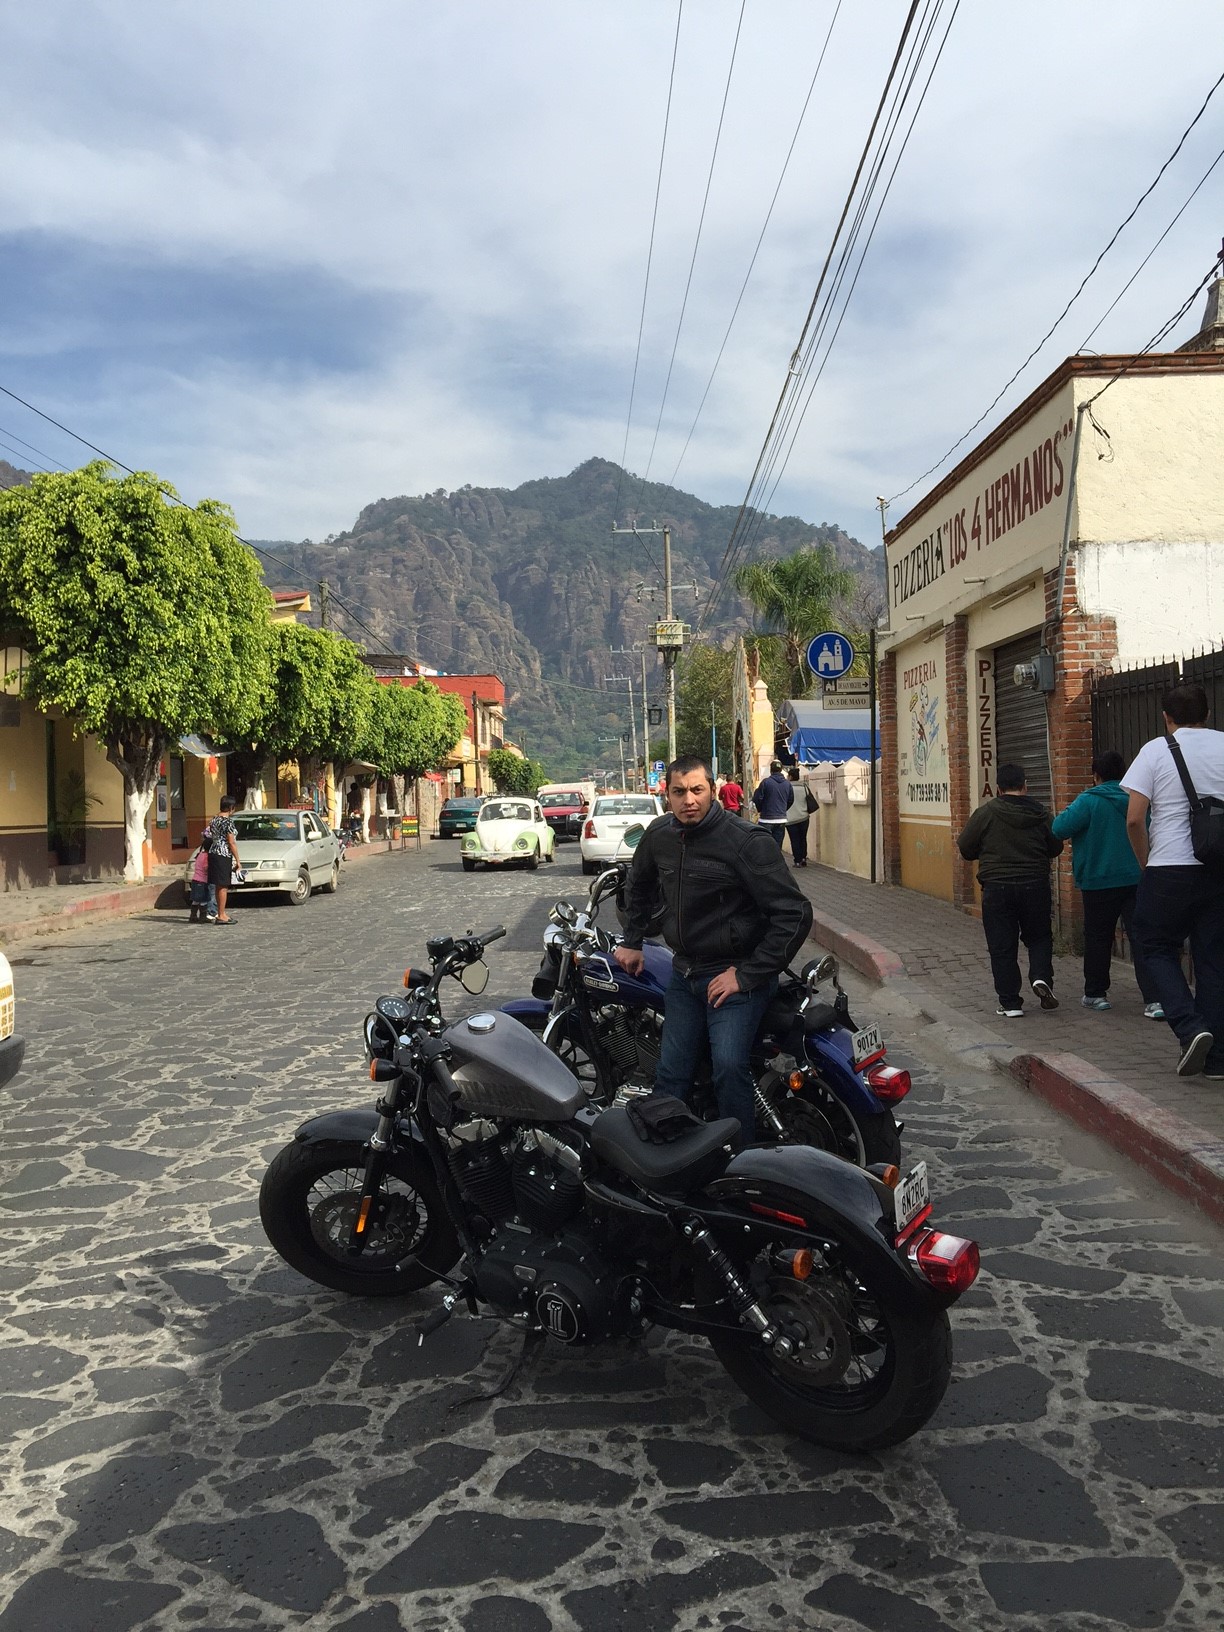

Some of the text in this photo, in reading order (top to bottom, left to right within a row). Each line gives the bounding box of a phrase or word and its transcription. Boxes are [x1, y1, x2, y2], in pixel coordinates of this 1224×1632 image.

[893, 526, 945, 608] PIZZERIA
[971, 496, 981, 551] 4
[903, 659, 937, 690] PIZZERIA
[840, 698, 848, 706] DE
[978, 660, 994, 797] PIZZERIA
[902, 1177, 925, 1216] 8N2RG
